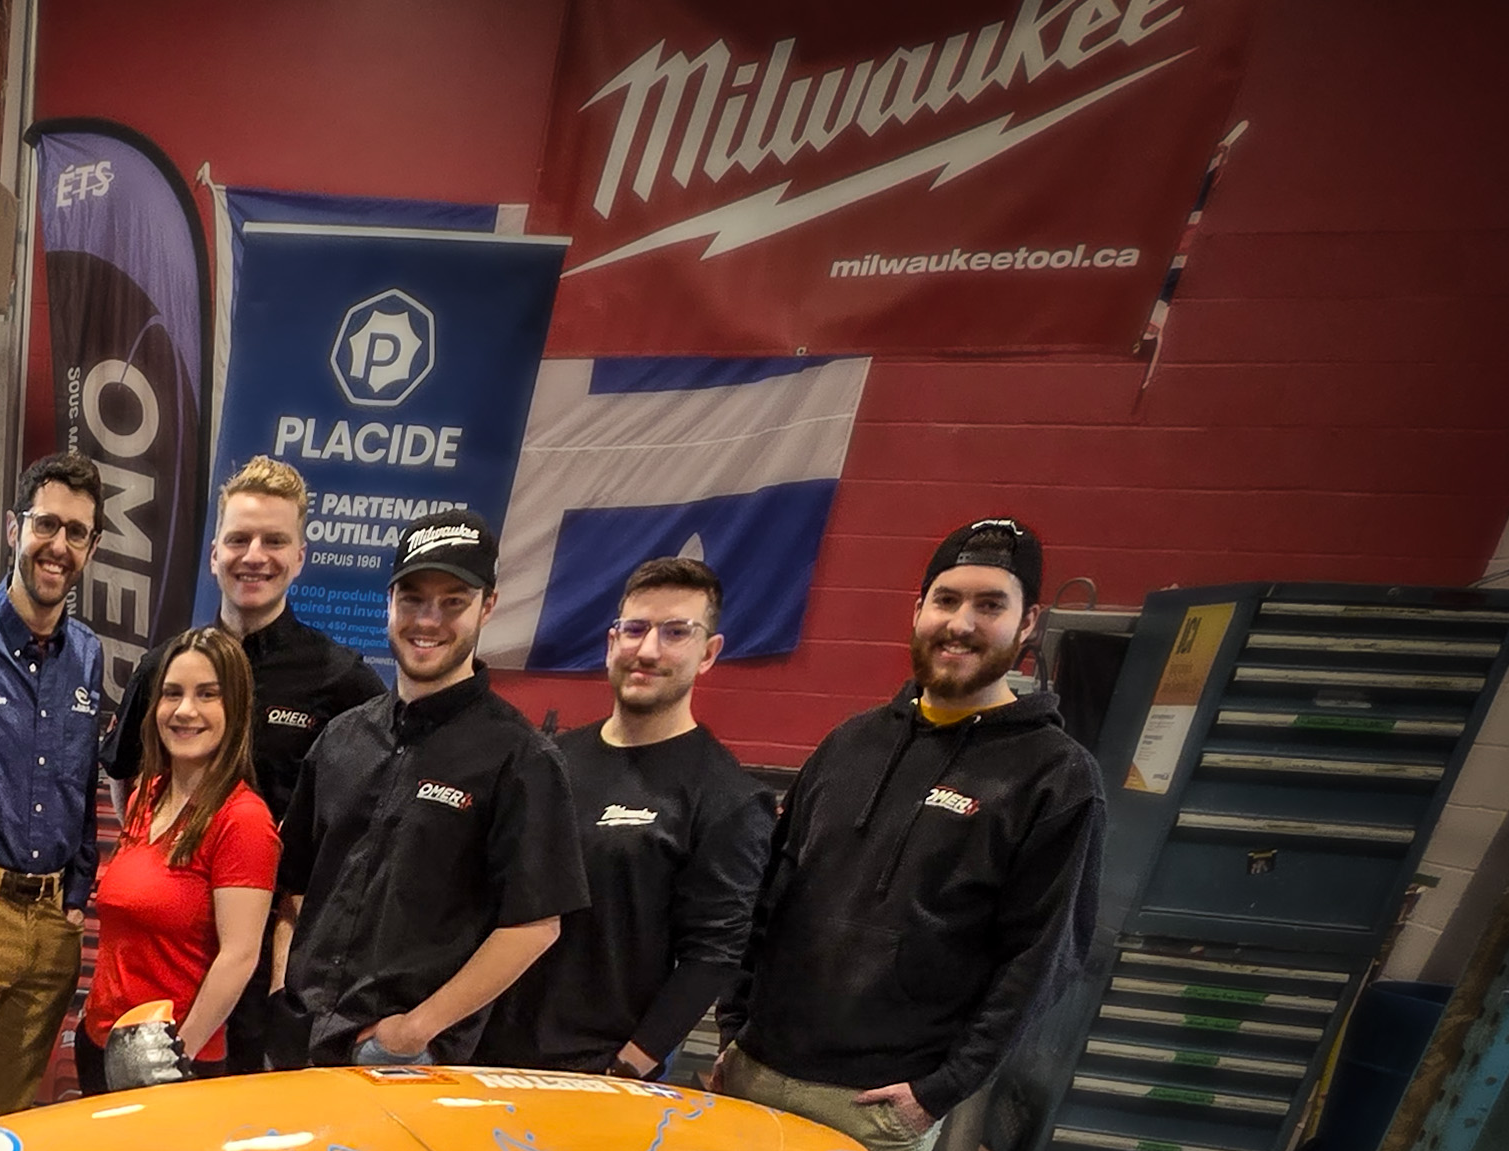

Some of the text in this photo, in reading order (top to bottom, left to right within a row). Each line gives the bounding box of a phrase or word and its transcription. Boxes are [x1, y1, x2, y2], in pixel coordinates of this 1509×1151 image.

[577, 0, 1184, 220] Milwaukee
[56, 159, 113, 208] ÉTS
[829, 244, 1140, 279] milwaukeetool.ca
[274, 416, 463, 468] PLACIDE
[311, 552, 382, 569] DEPUIS 1961
[300, 586, 326, 598] 000
[268, 708, 309, 727] OMER
[418, 782, 464, 804] OMER
